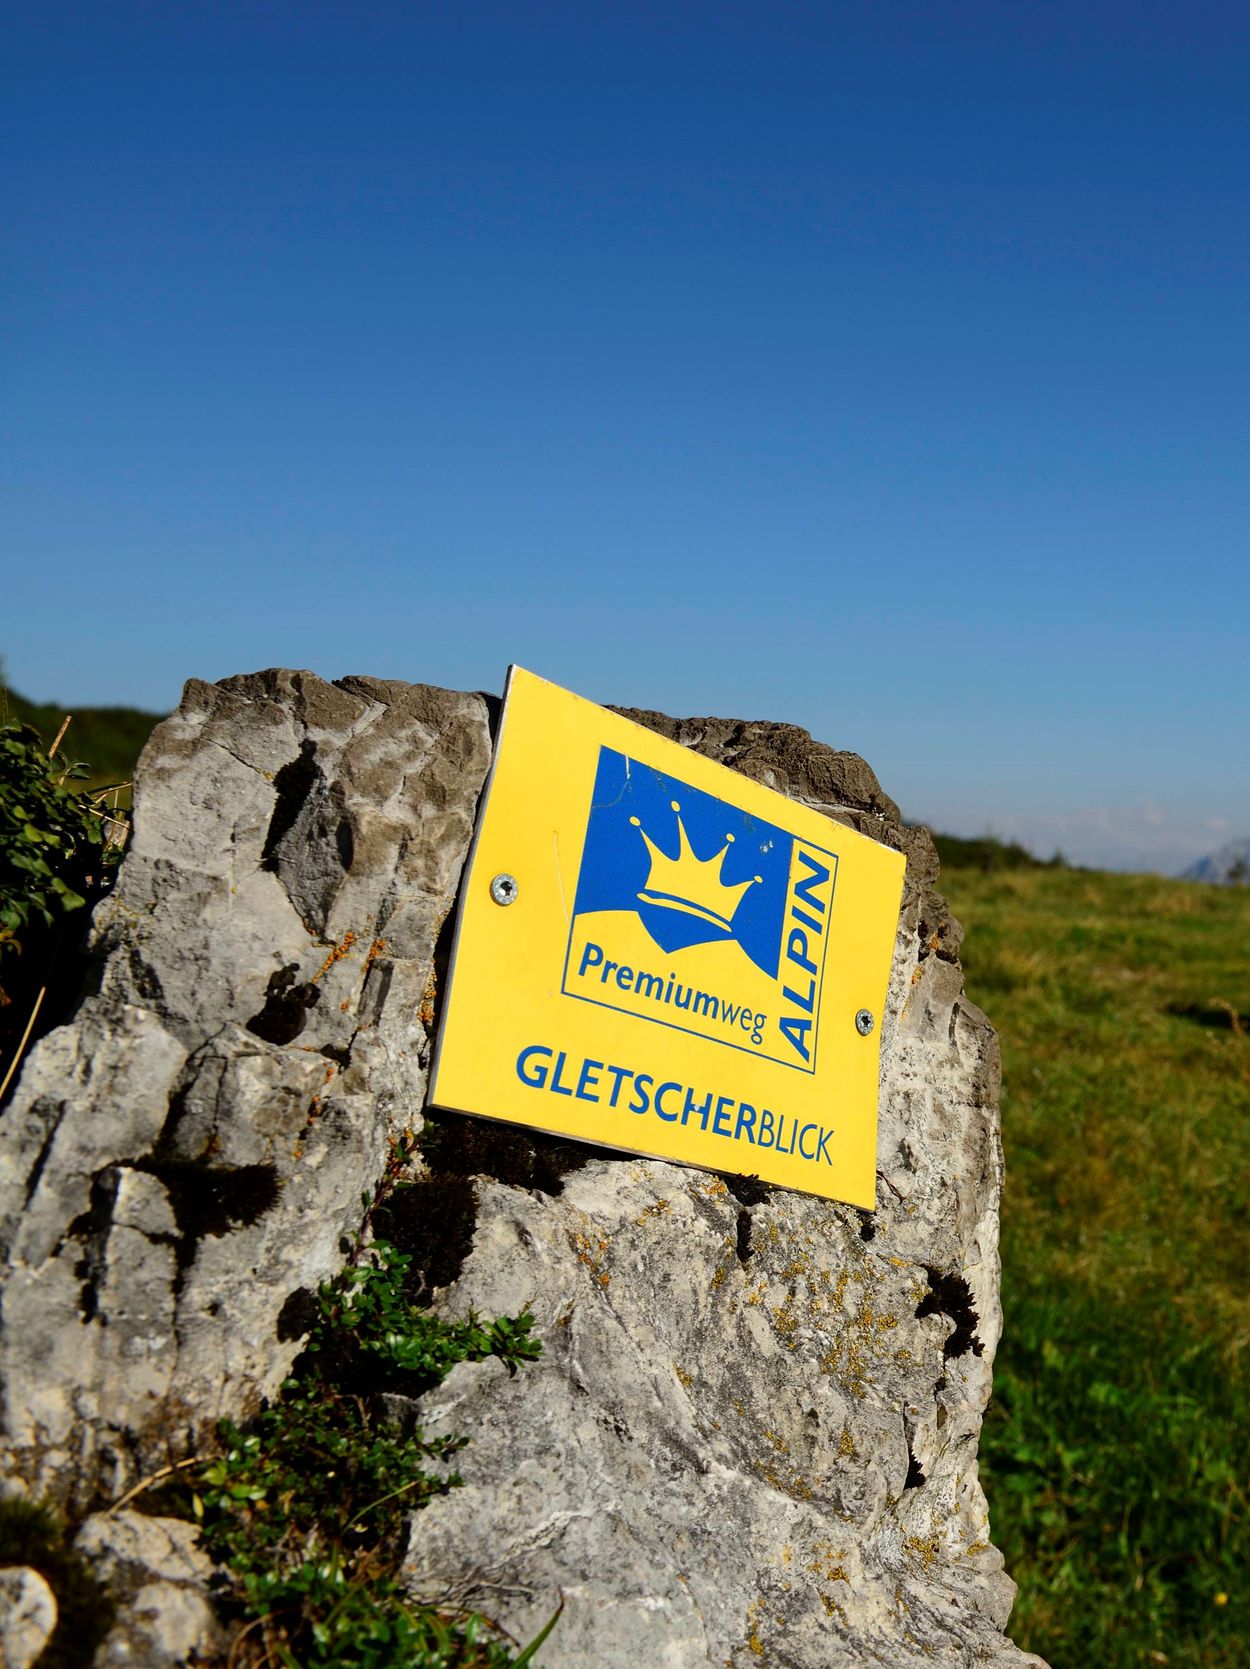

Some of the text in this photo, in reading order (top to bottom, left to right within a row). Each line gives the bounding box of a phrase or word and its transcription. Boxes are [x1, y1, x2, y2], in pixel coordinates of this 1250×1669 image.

[578, 942, 767, 1045] Premiumweg
[779, 850, 830, 1063] ALPIN
[516, 1045, 835, 1166] GLETSCHERBLICK
